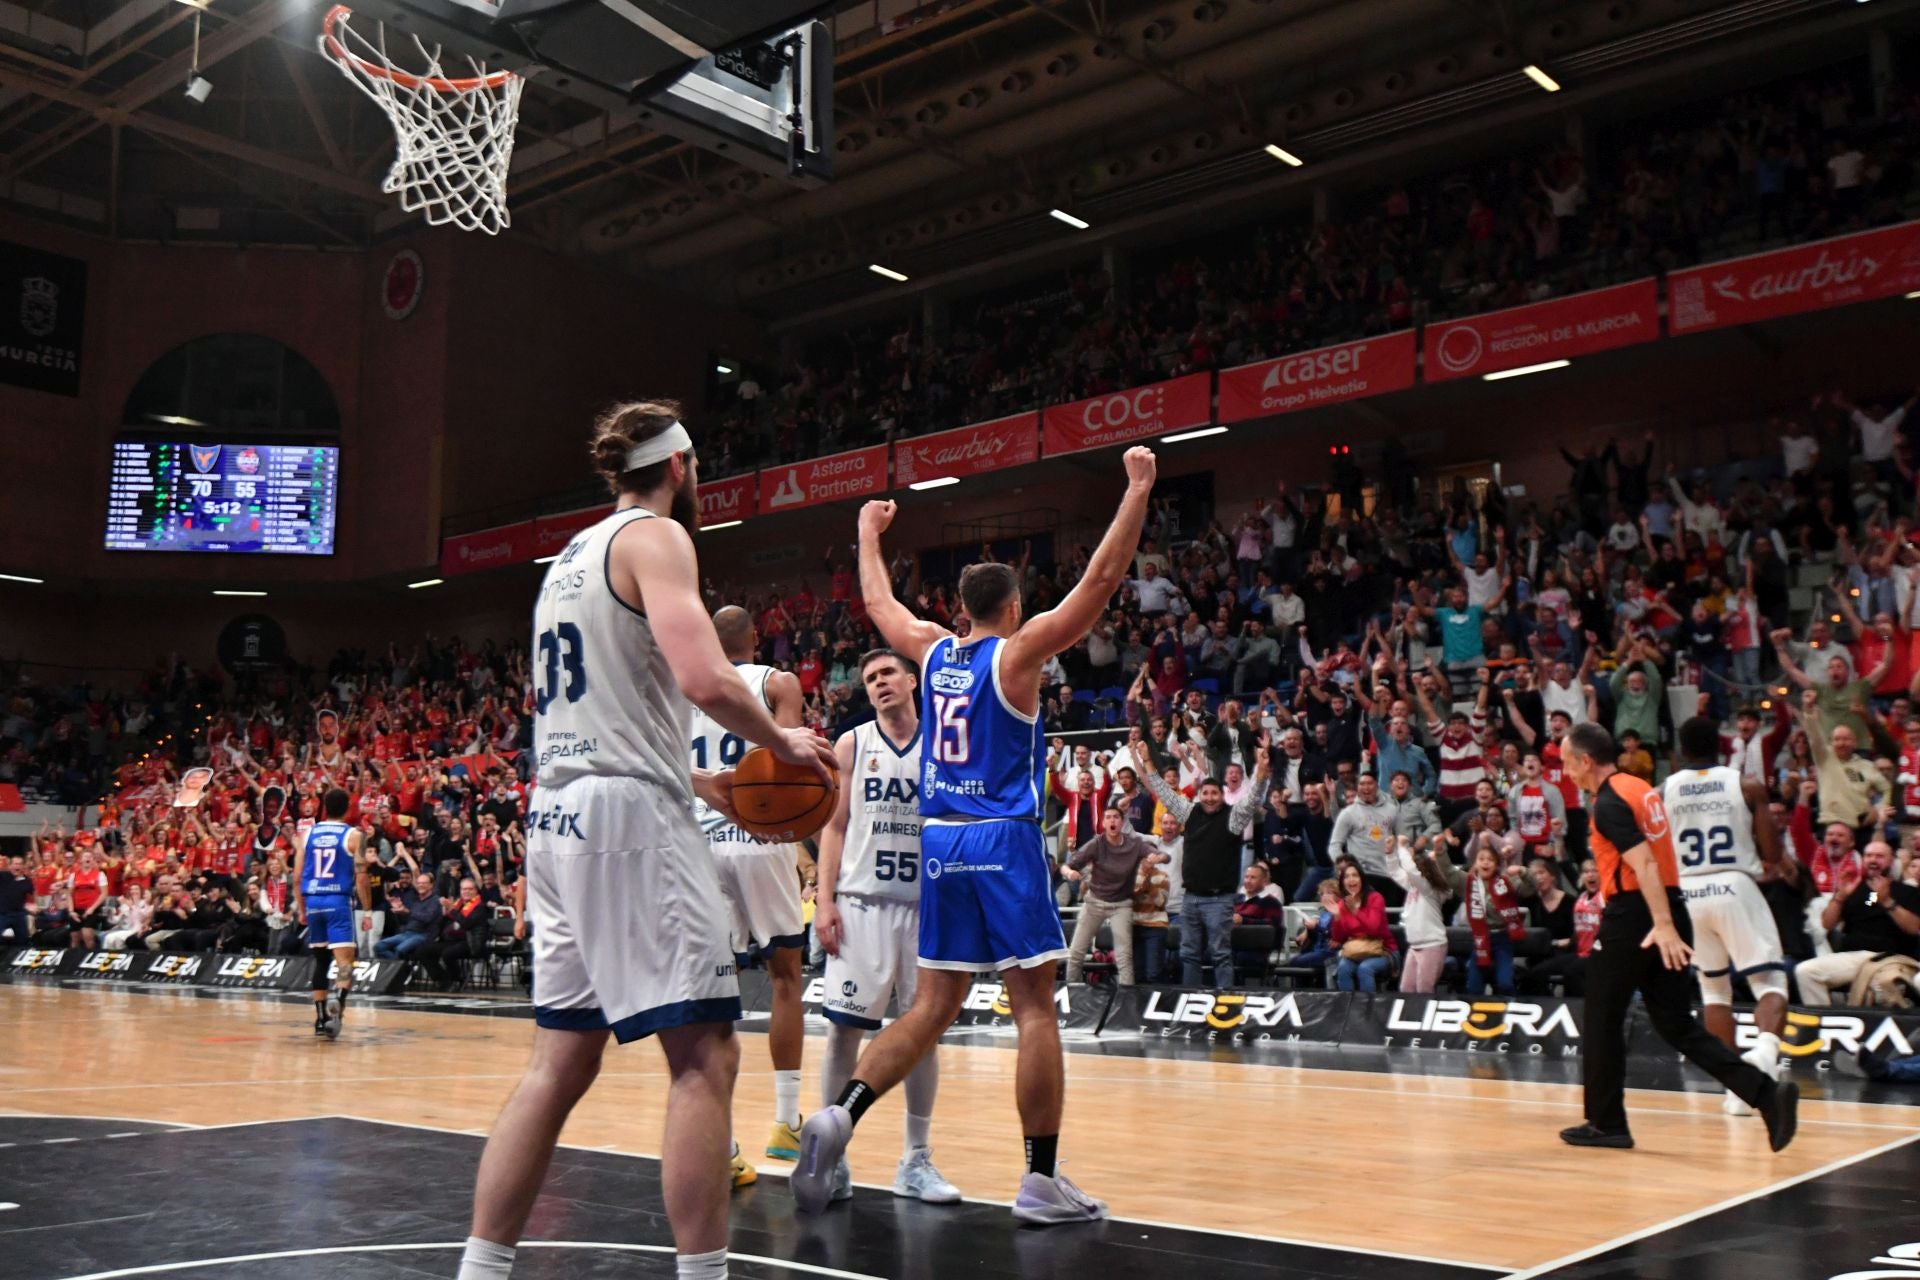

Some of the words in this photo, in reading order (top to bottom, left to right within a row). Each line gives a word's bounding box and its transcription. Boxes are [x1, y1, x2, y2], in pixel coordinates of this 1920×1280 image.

[1551, 326, 1571, 342] DE
[1576, 311, 1641, 338] MURCIA
[1282, 345, 1368, 385] caser
[1261, 394, 1306, 410] Grupo
[1308, 380, 1368, 400] Helvetia
[1082, 419, 1165, 446] OFTALMOLOGÍA
[810, 455, 866, 480] Asterra
[190, 480, 213, 497] 70
[235, 481, 257, 498] 55
[809, 474, 875, 500] Partners
[203, 501, 242, 515] 5:12
[537, 621, 587, 717] 33
[943, 646, 972, 666] CATE
[932, 693, 971, 765] 15
[864, 777, 920, 804] BAX
[935, 780, 986, 795] MURCIA
[1679, 825, 1737, 867] 32
[313, 848, 337, 878] 12
[875, 849, 920, 884] 55
[976, 864, 1003, 872] MURCIA
[827, 997, 868, 1014] unilabor
[1143, 991, 1304, 1030] LIBERA
[1386, 997, 1581, 1039] LIBERA
[1138, 1025, 1301, 1044] TELECOM
[1383, 1036, 1579, 1057] TELECOM
